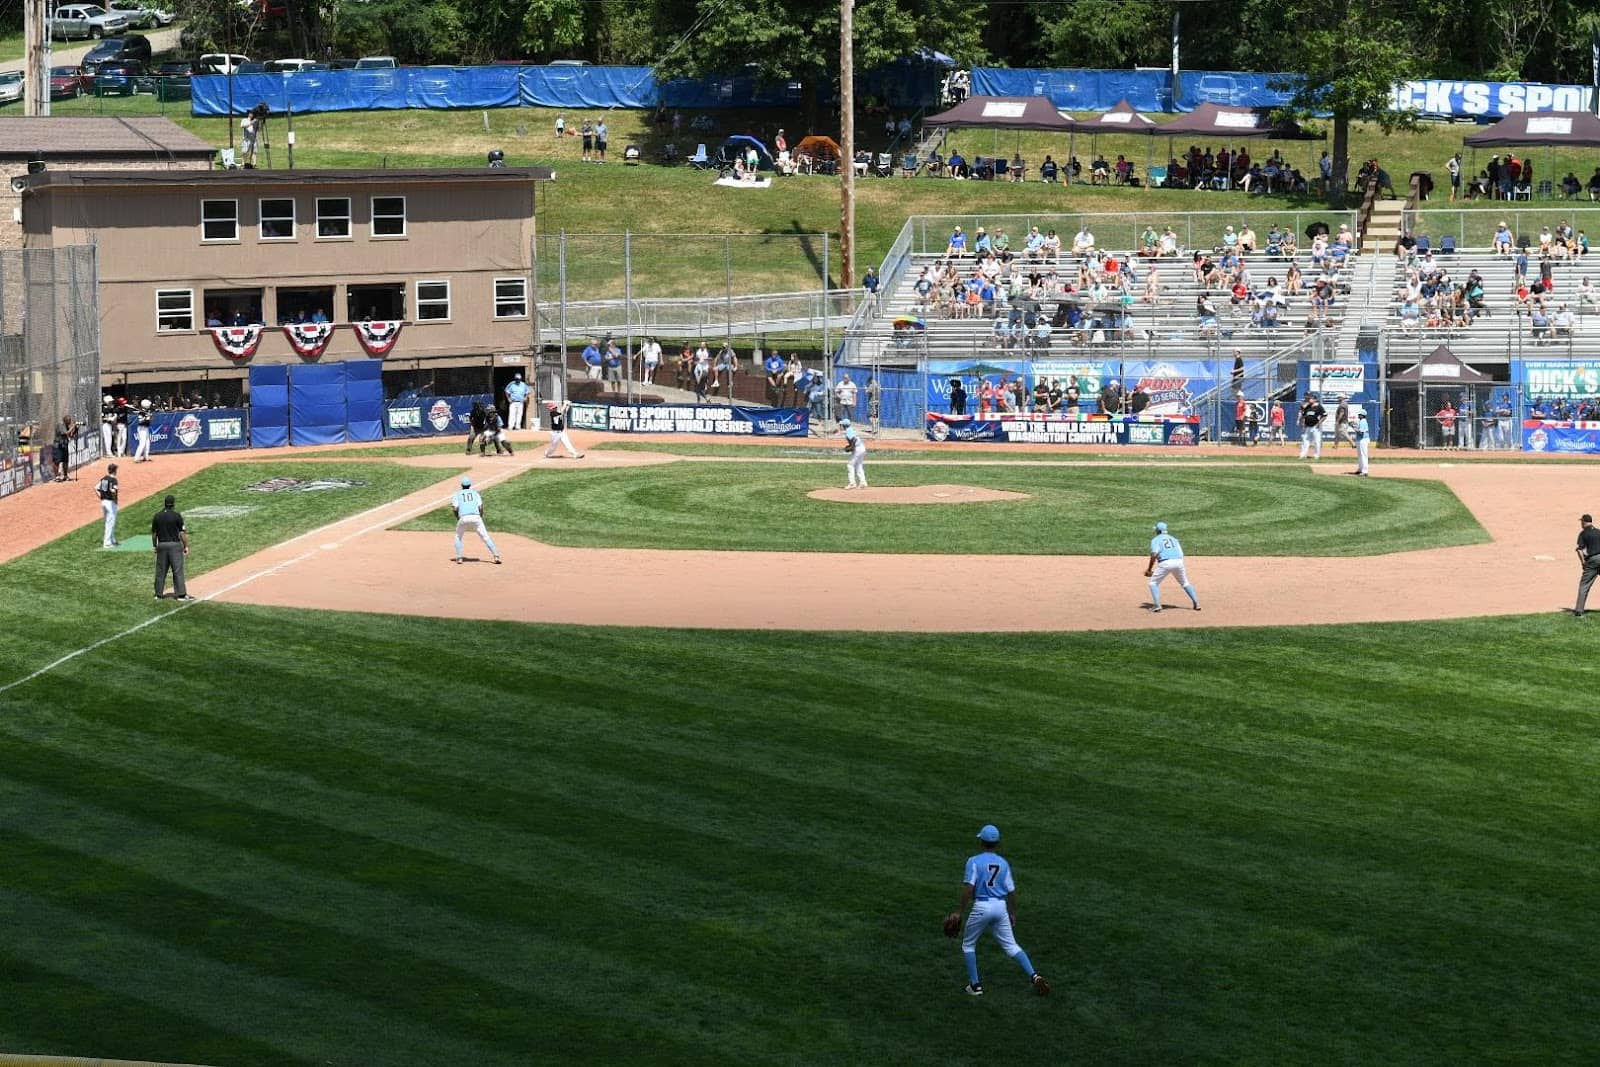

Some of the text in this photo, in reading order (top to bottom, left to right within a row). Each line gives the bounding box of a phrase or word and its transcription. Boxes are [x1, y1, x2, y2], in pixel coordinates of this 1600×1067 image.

[1388, 81, 1490, 113] ICK'S
[1136, 378, 1187, 392] PONY
[1529, 369, 1598, 393] DICK'S
[572, 408, 606, 424] DICK'S
[640, 407, 694, 419] SPORTING
[696, 408, 732, 420] GOODS
[633, 419, 674, 431] LEAGUE
[675, 420, 713, 432] WORLD
[715, 421, 753, 433] SERIES
[987, 863, 1000, 887] 7
